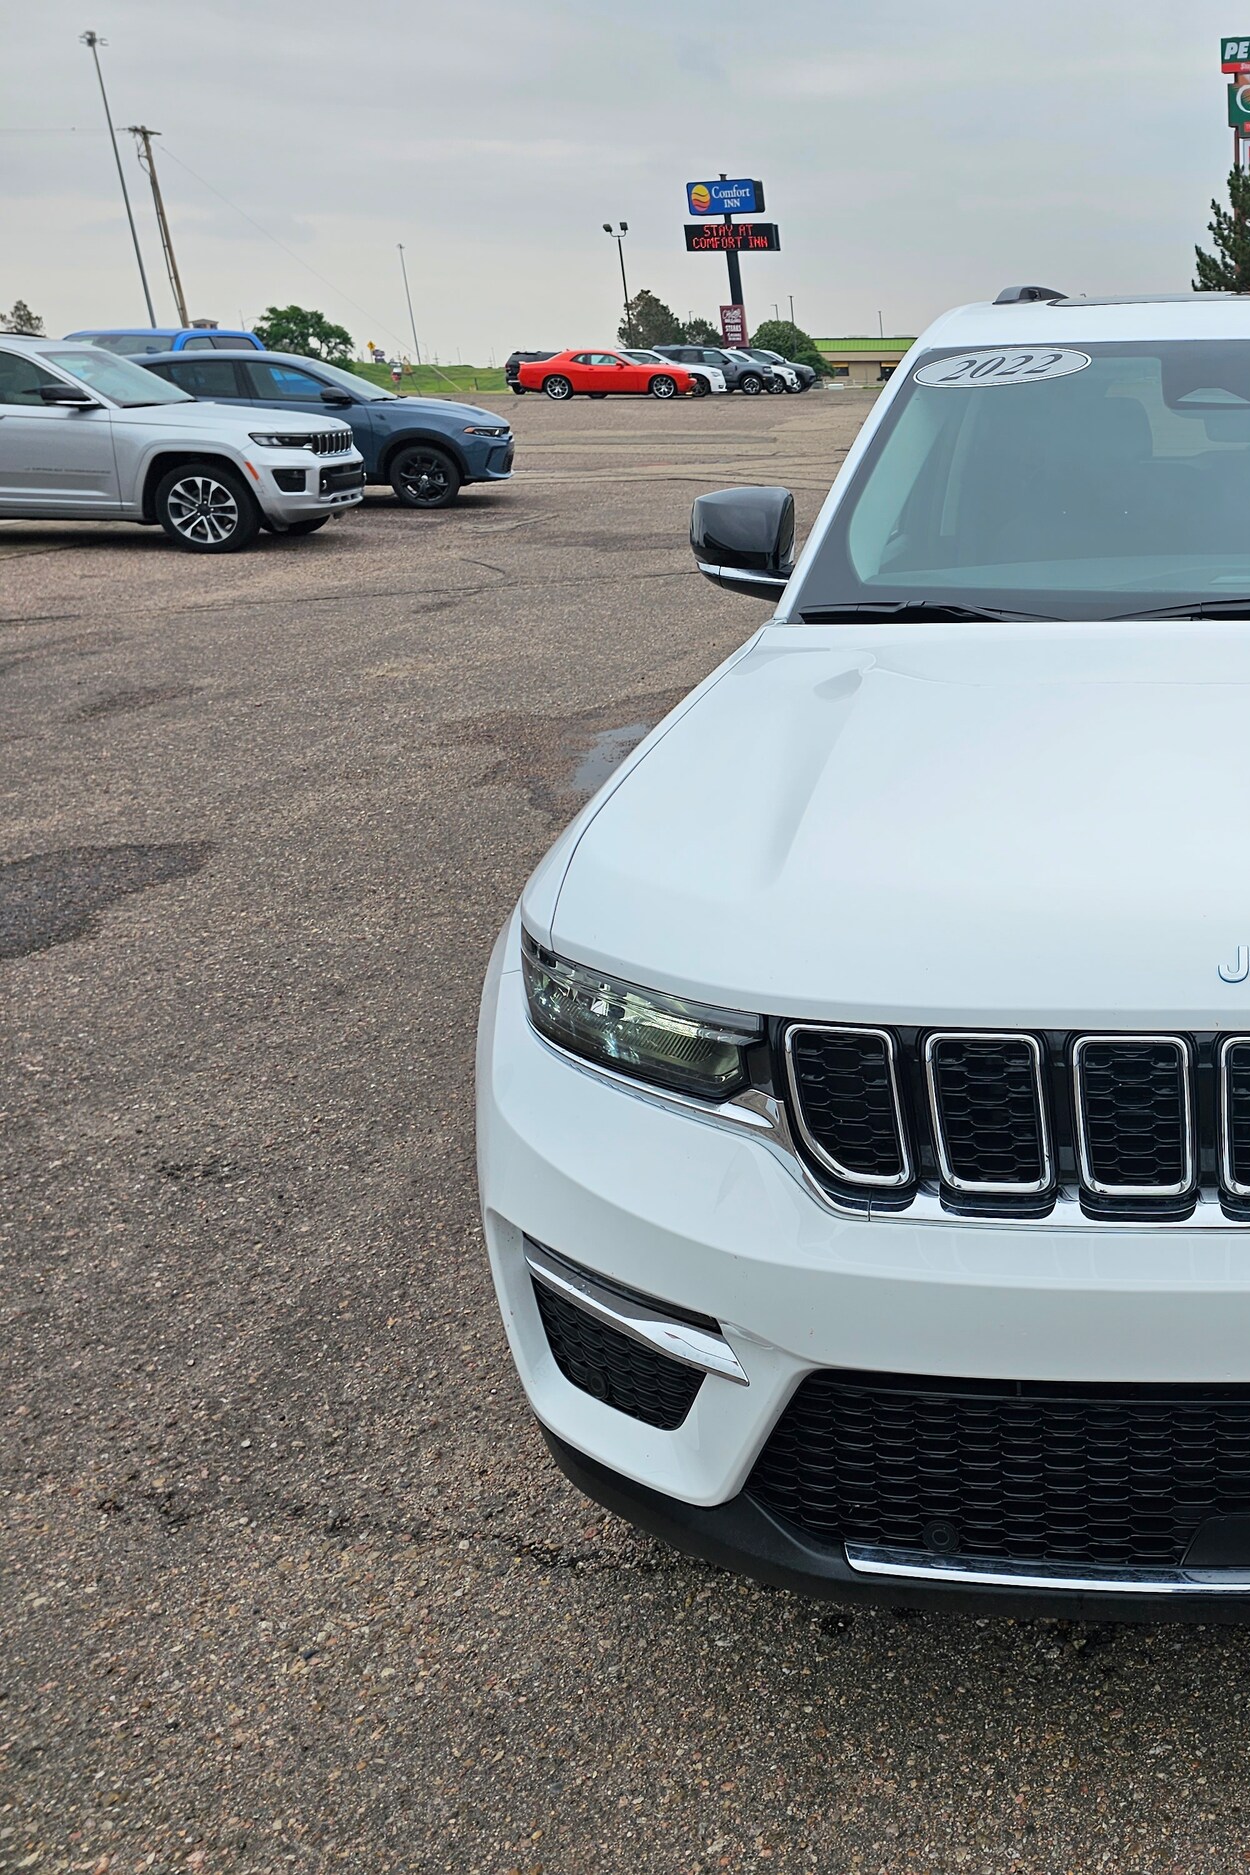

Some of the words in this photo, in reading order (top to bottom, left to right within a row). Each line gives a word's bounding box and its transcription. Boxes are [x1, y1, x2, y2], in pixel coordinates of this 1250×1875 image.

[711, 184, 751, 199] Comfort
[724, 199, 741, 208] INN
[703, 224, 733, 237] STAY
[738, 224, 753, 236] AT
[692, 236, 742, 249] COMFORT
[748, 236, 768, 248] INN
[936, 353, 1063, 383] 2022
